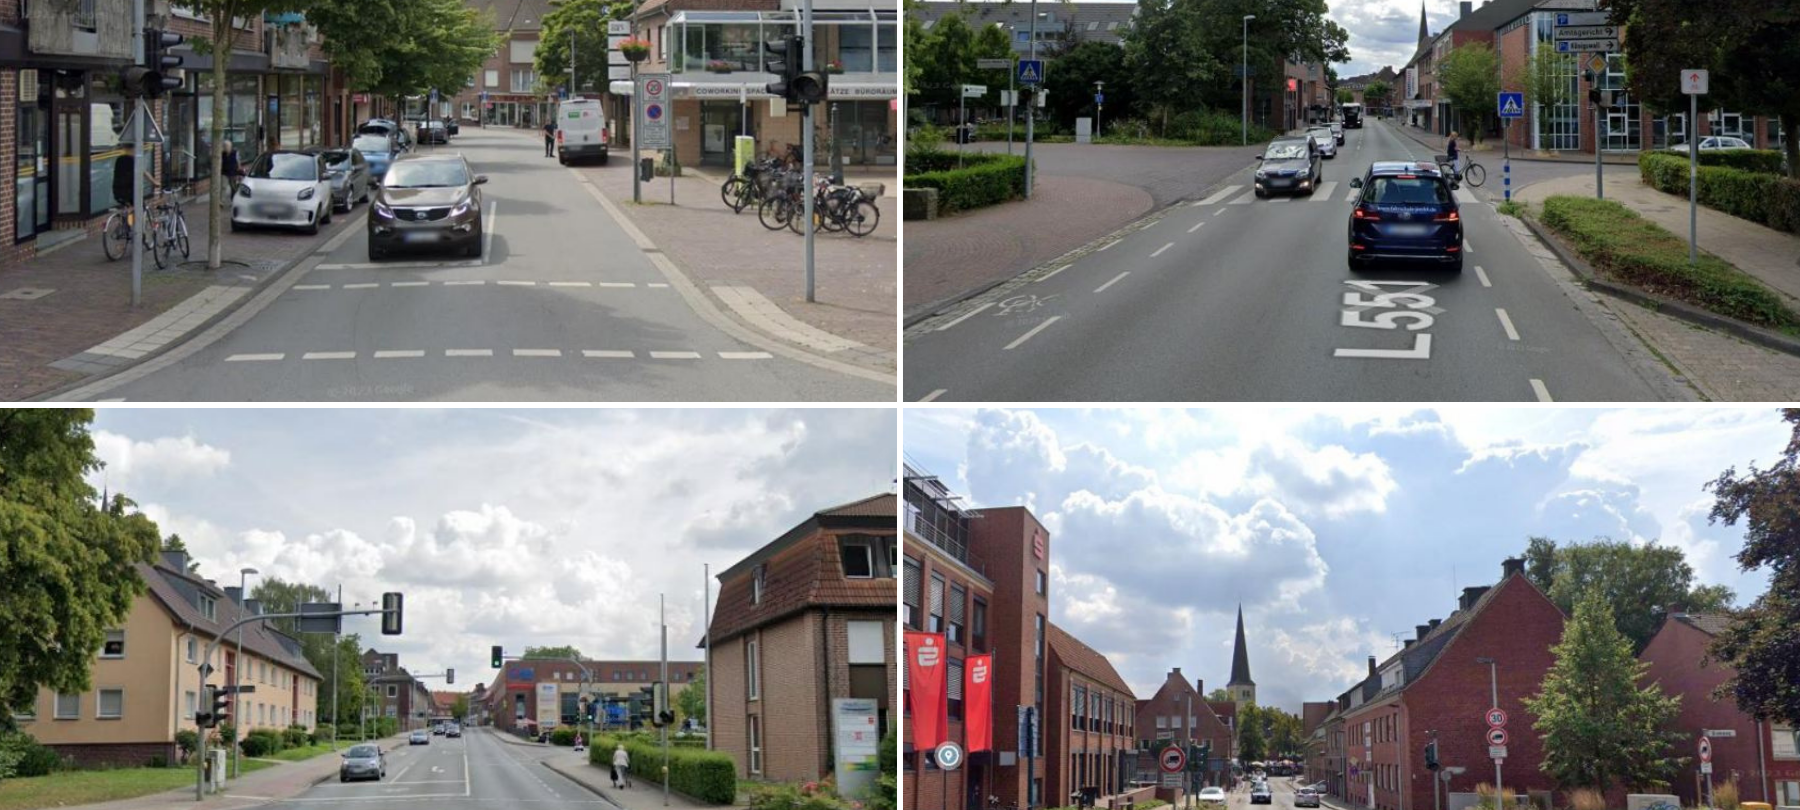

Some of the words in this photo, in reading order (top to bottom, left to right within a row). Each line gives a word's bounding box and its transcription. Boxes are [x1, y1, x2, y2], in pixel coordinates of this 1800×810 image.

[1559, 28, 1603, 38] Amtsgericht
[696, 87, 741, 95] COWORKIN
[747, 87, 767, 95] SPAC
[830, 86, 850, 95] ÄTZE
[1490, 713, 1503, 723] 30
